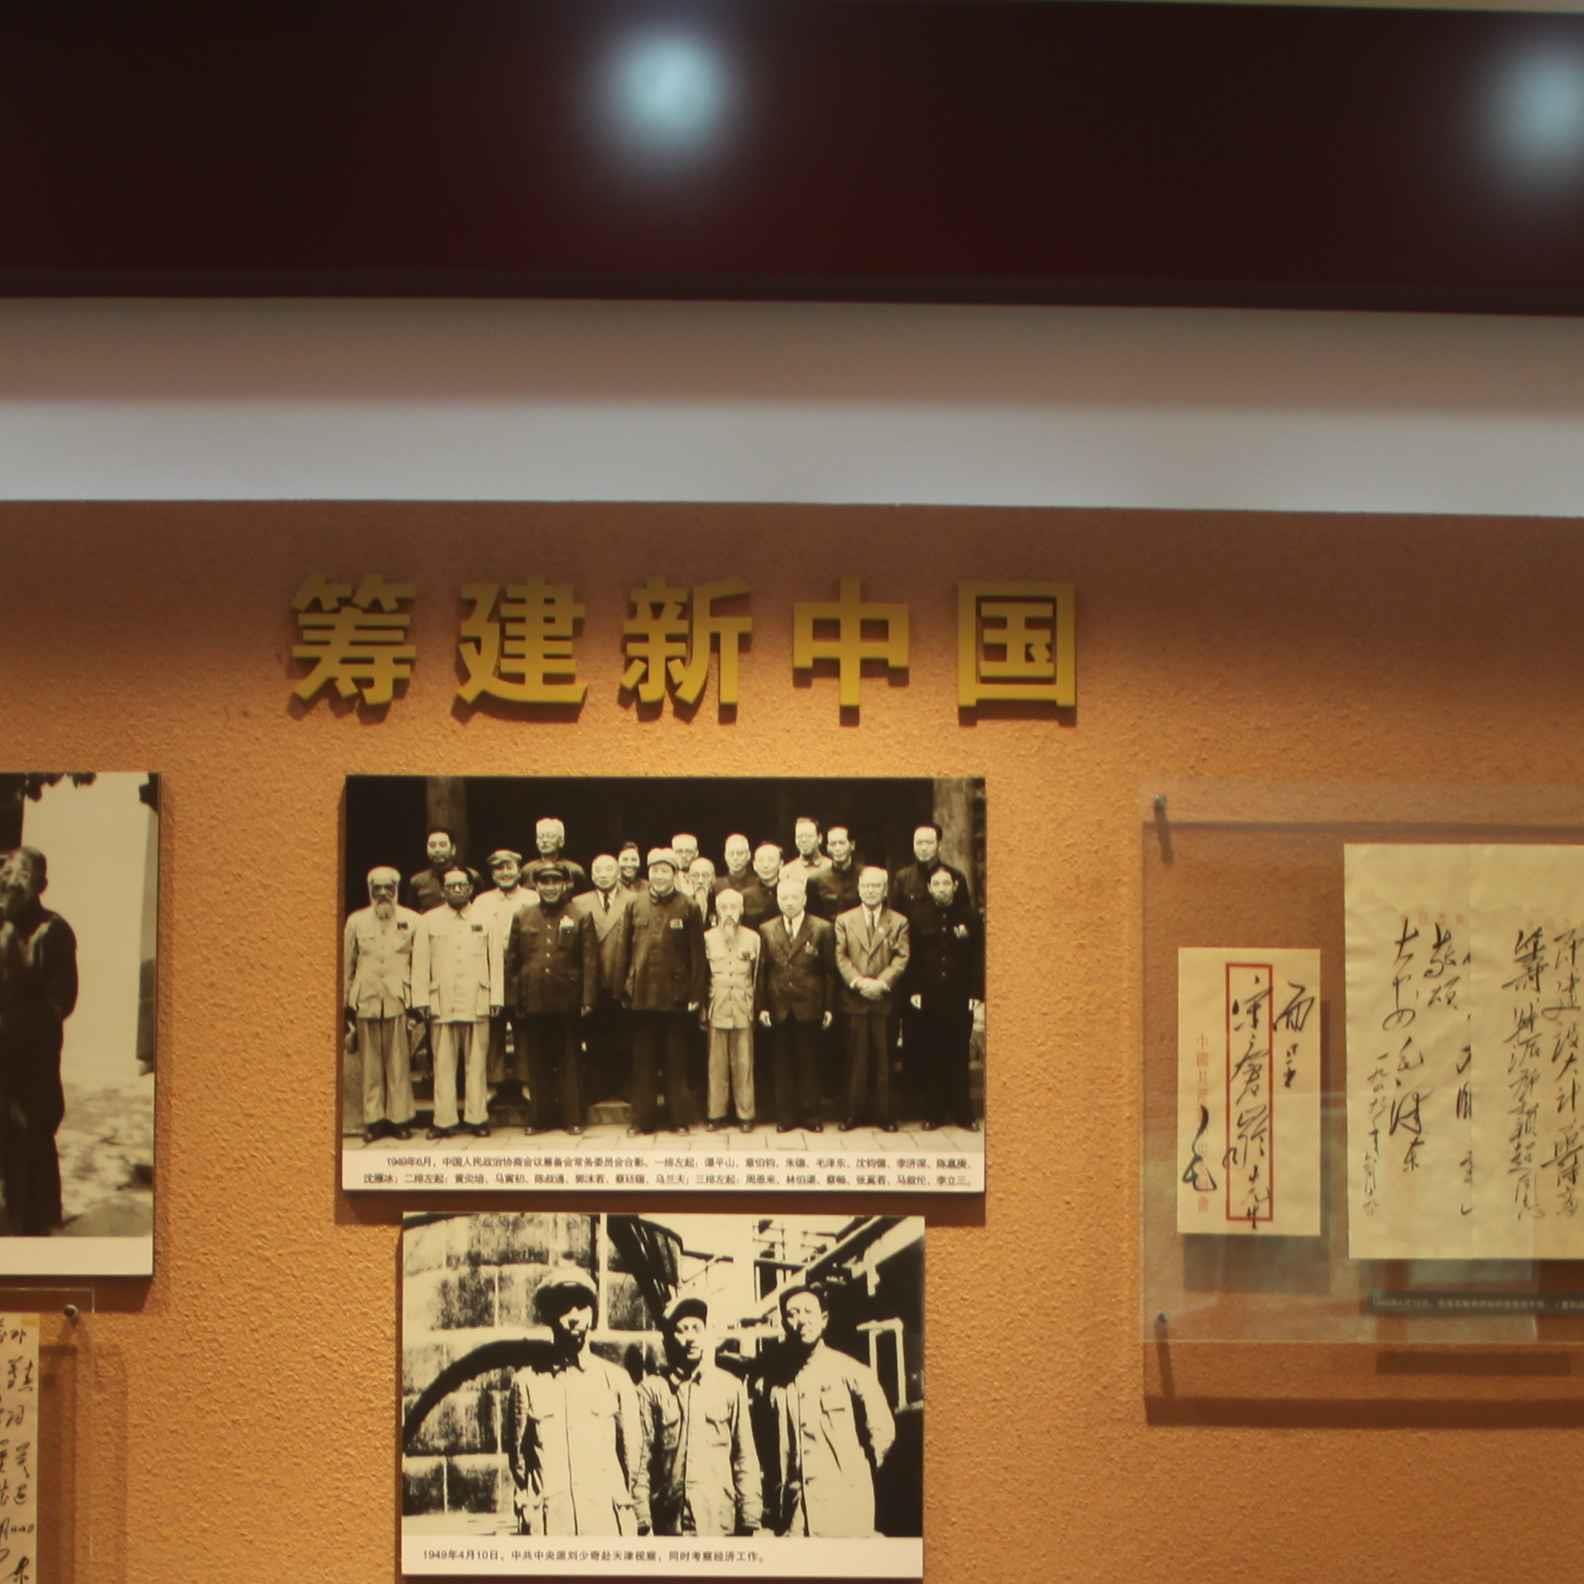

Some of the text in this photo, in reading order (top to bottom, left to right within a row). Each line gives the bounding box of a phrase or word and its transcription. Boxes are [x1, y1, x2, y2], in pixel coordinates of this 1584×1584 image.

[291, 572, 1078, 709] 筹建新中国
